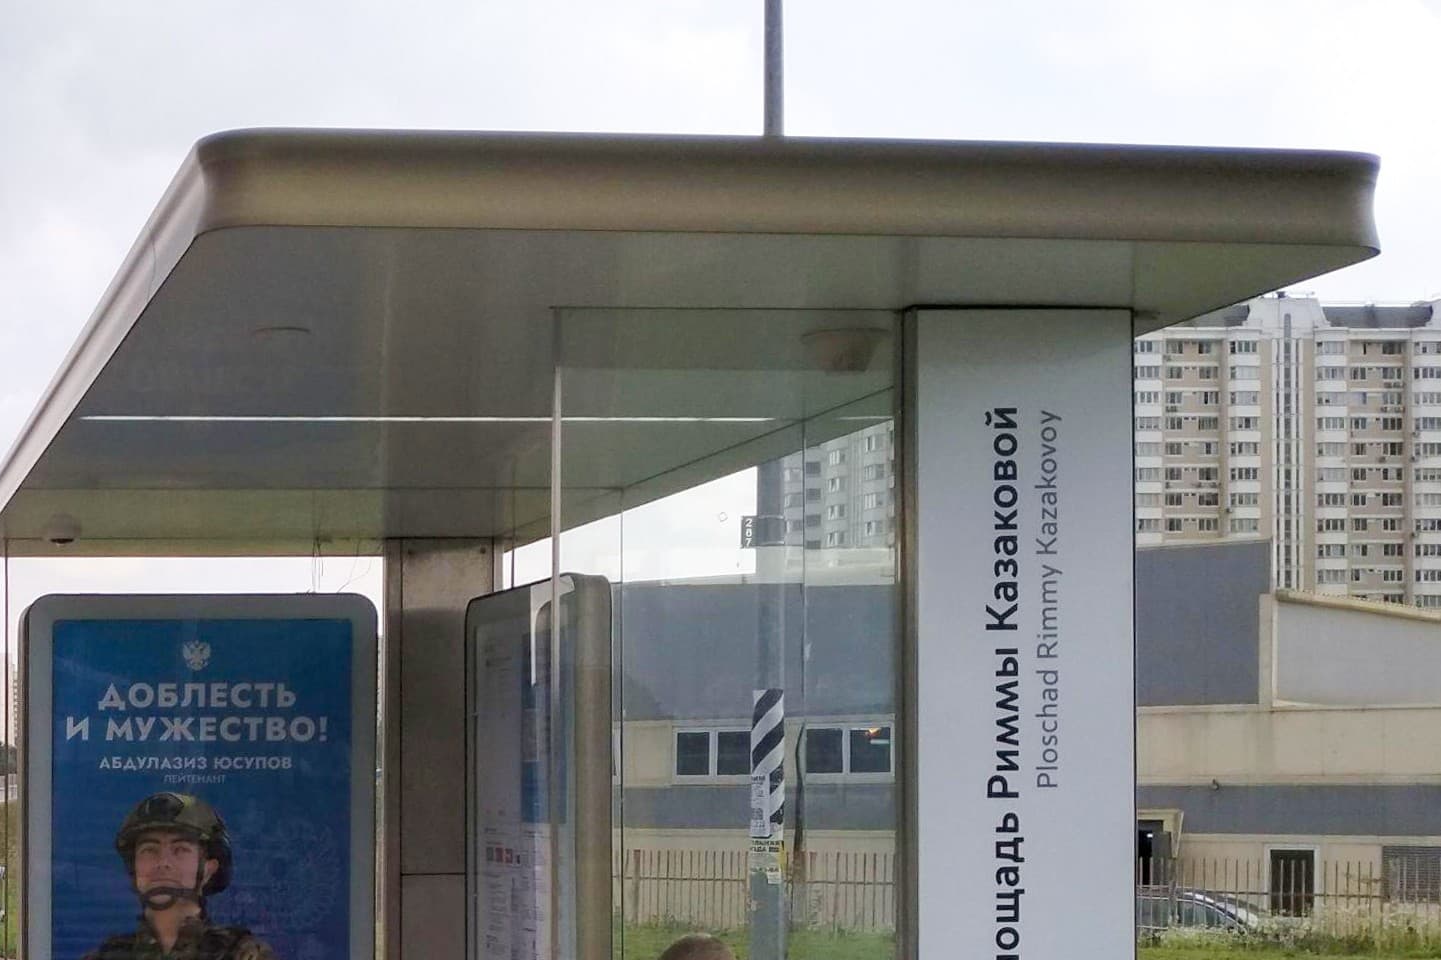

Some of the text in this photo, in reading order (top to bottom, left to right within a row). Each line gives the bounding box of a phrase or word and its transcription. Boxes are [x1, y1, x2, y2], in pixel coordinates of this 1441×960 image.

[744, 518, 753, 548] 207
[984, 407, 1019, 631] Казаковой
[1034, 410, 1063, 788] Ploschad Rimmy Kazakovoy
[97, 682, 297, 711] ДОБЛЕСТЬ
[66, 716, 328, 742] И МУЖЕСТВО!
[986, 648, 1019, 799] Риммы
[99, 756, 292, 771] АБДУЛАЗИЗ ЮСУПОВ
[163, 773, 227, 785] ЛЕЙТЕНАНТ
